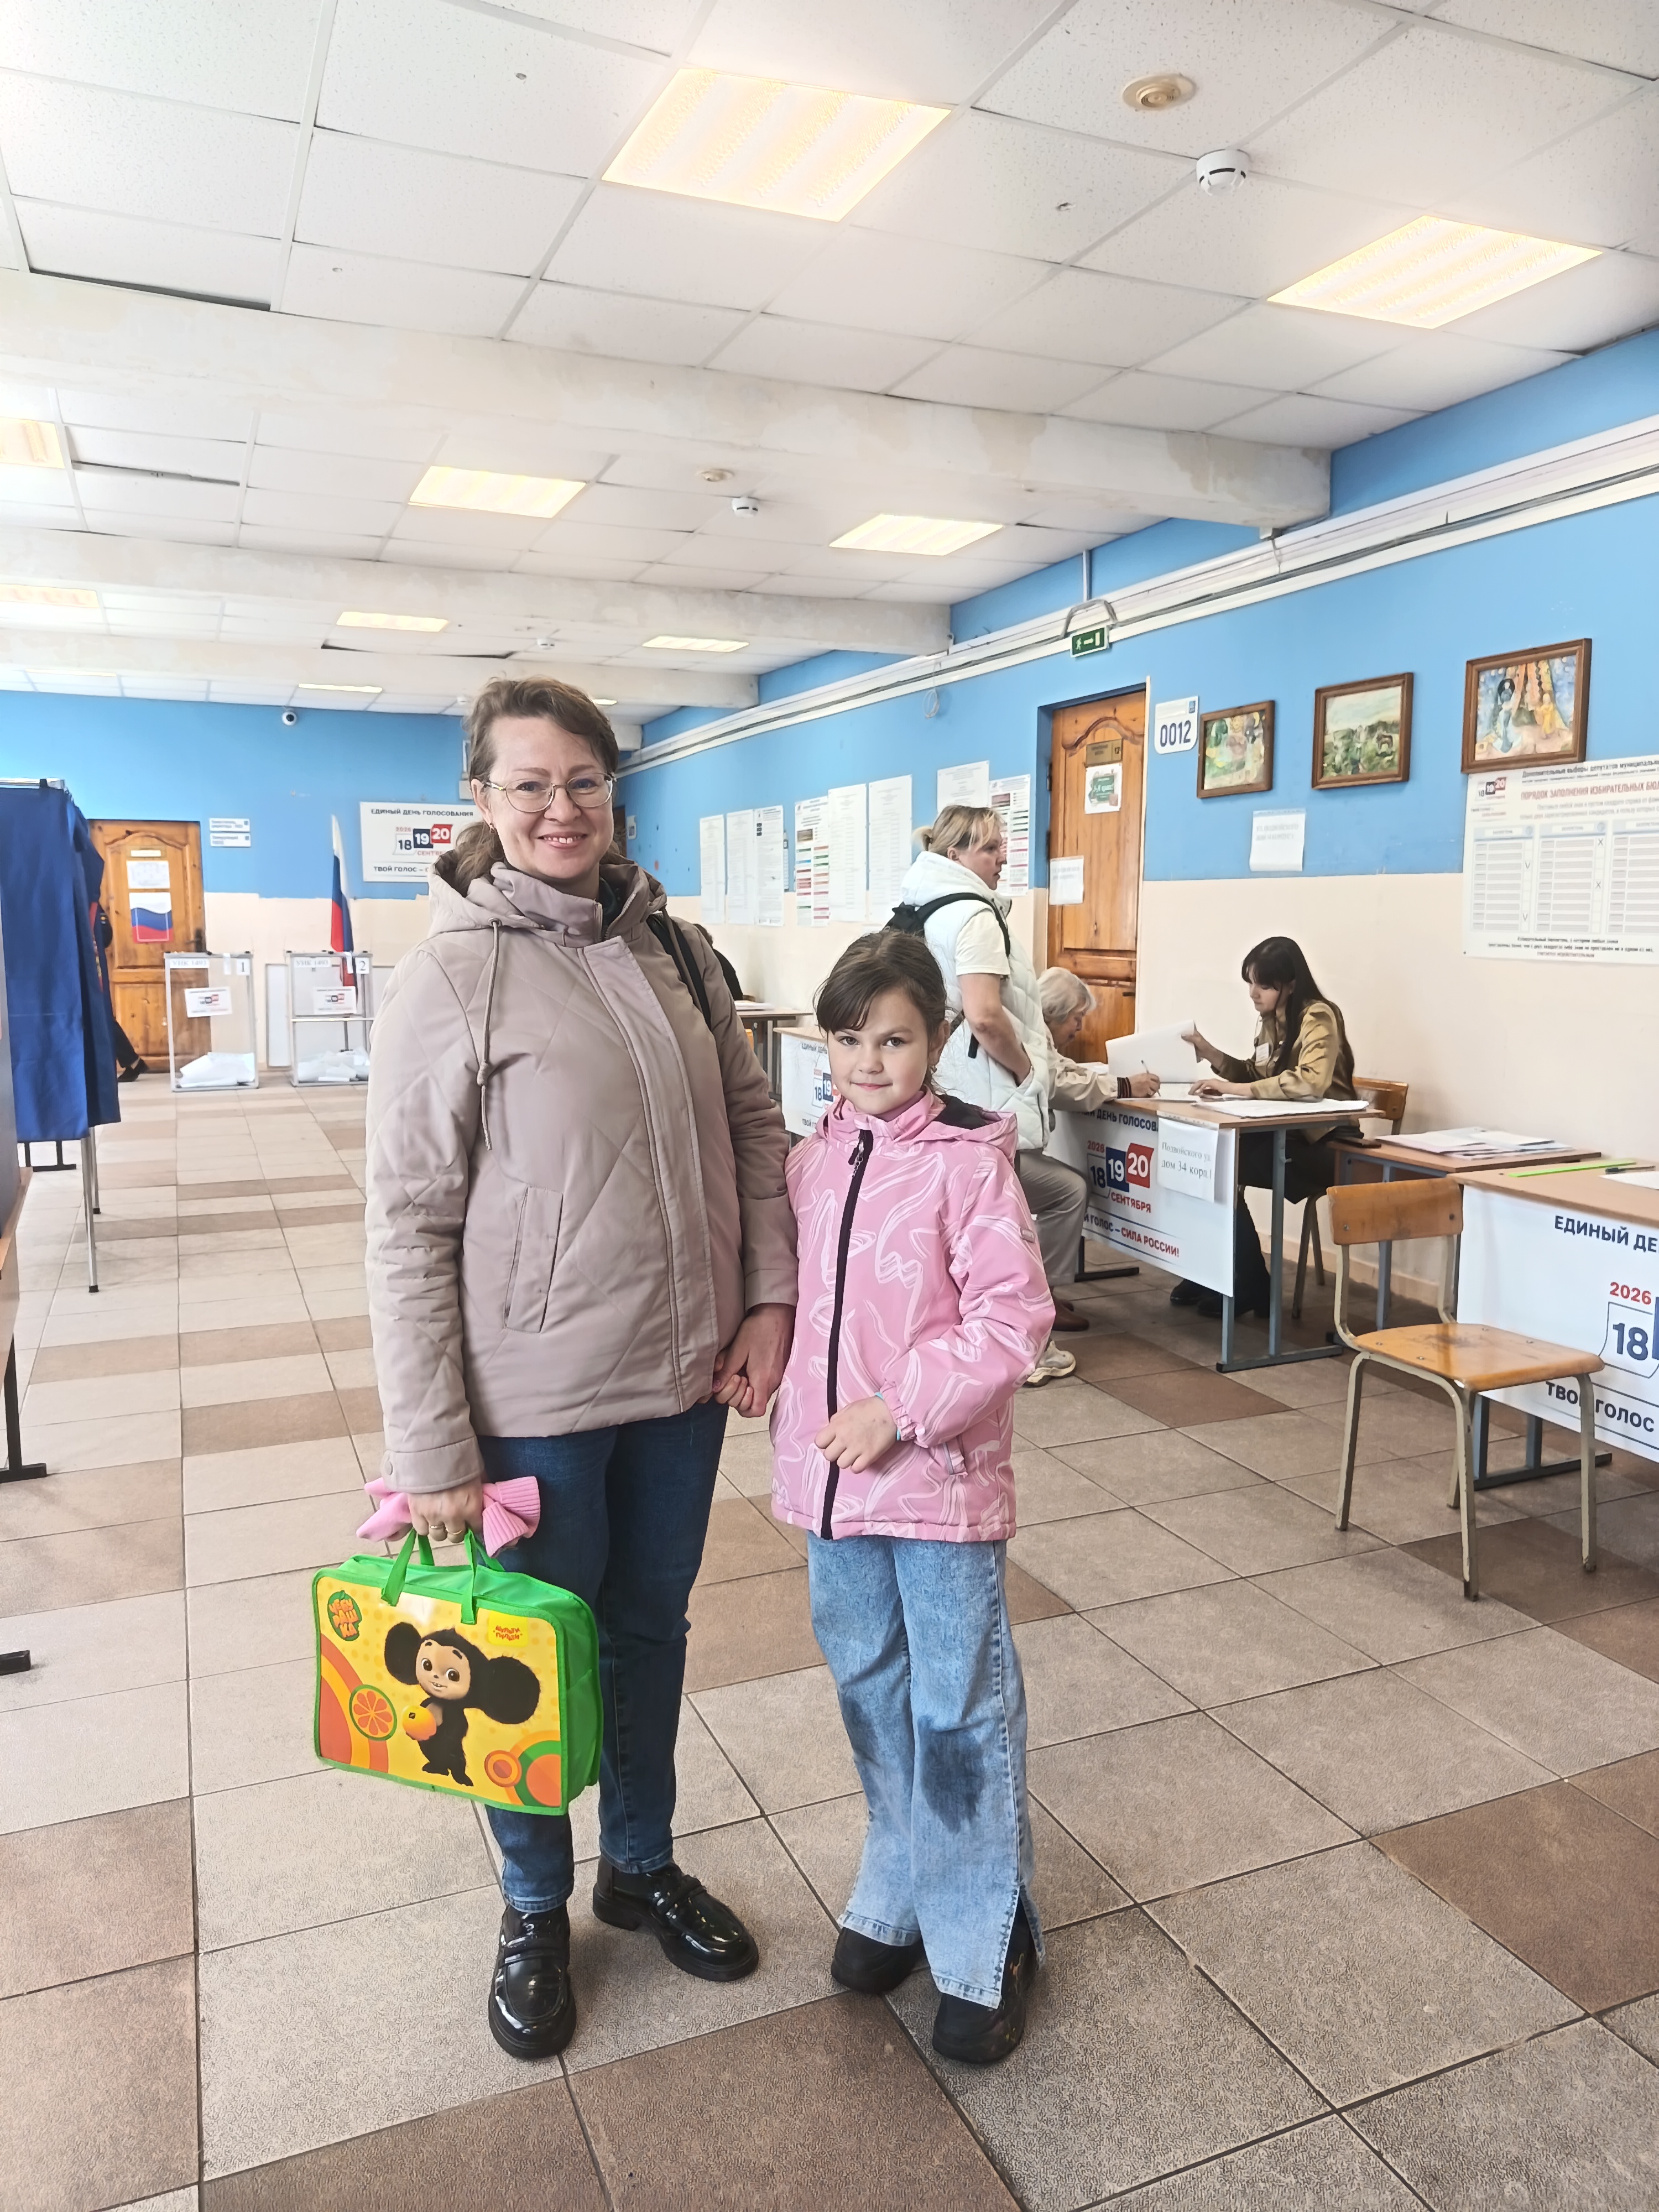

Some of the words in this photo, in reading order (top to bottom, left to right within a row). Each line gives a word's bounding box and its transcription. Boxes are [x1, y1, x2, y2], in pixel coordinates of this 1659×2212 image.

[1160, 720, 1191, 747] 0012
[398, 839, 412, 850] 18
[415, 833, 430, 845] 19
[432, 827, 450, 840] 20
[241, 962, 245, 973] 1
[359, 961, 366, 971] 2
[815, 1086, 822, 1101] 18
[823, 1079, 832, 1096] 19
[1097, 1109, 1117, 1121] ДЕНЬ
[1119, 1114, 1159, 1132] ГОЛОСОВ
[1162, 1142, 1202, 1159] Подвойского
[1090, 1166, 1105, 1188] 18
[1108, 1159, 1124, 1182] 19
[1128, 1152, 1149, 1178] 20
[1161, 1160, 1175, 1170] дом
[1178, 1161, 1187, 1172] 34
[1111, 1192, 1152, 1213] СЕНТЯБРЯ
[1090, 1214, 1114, 1232] ГОЛОС
[1121, 1227, 1142, 1243] СИЛА
[1144, 1235, 1180, 1258] РОССИИ!
[1554, 1215, 1629, 1246] ЕДИНЫЙ
[1634, 1234, 1659, 1253] ДЕ
[1610, 1281, 1652, 1306] 2026
[1613, 1322, 1649, 1361] 18
[1546, 1381, 1581, 1407] ТВО
[1595, 1399, 1655, 1433] ГОЛОС
[328, 1598, 353, 1615] ЧЕБУ
[332, 1609, 359, 1629] РАШ
[340, 1623, 358, 1639] КА
